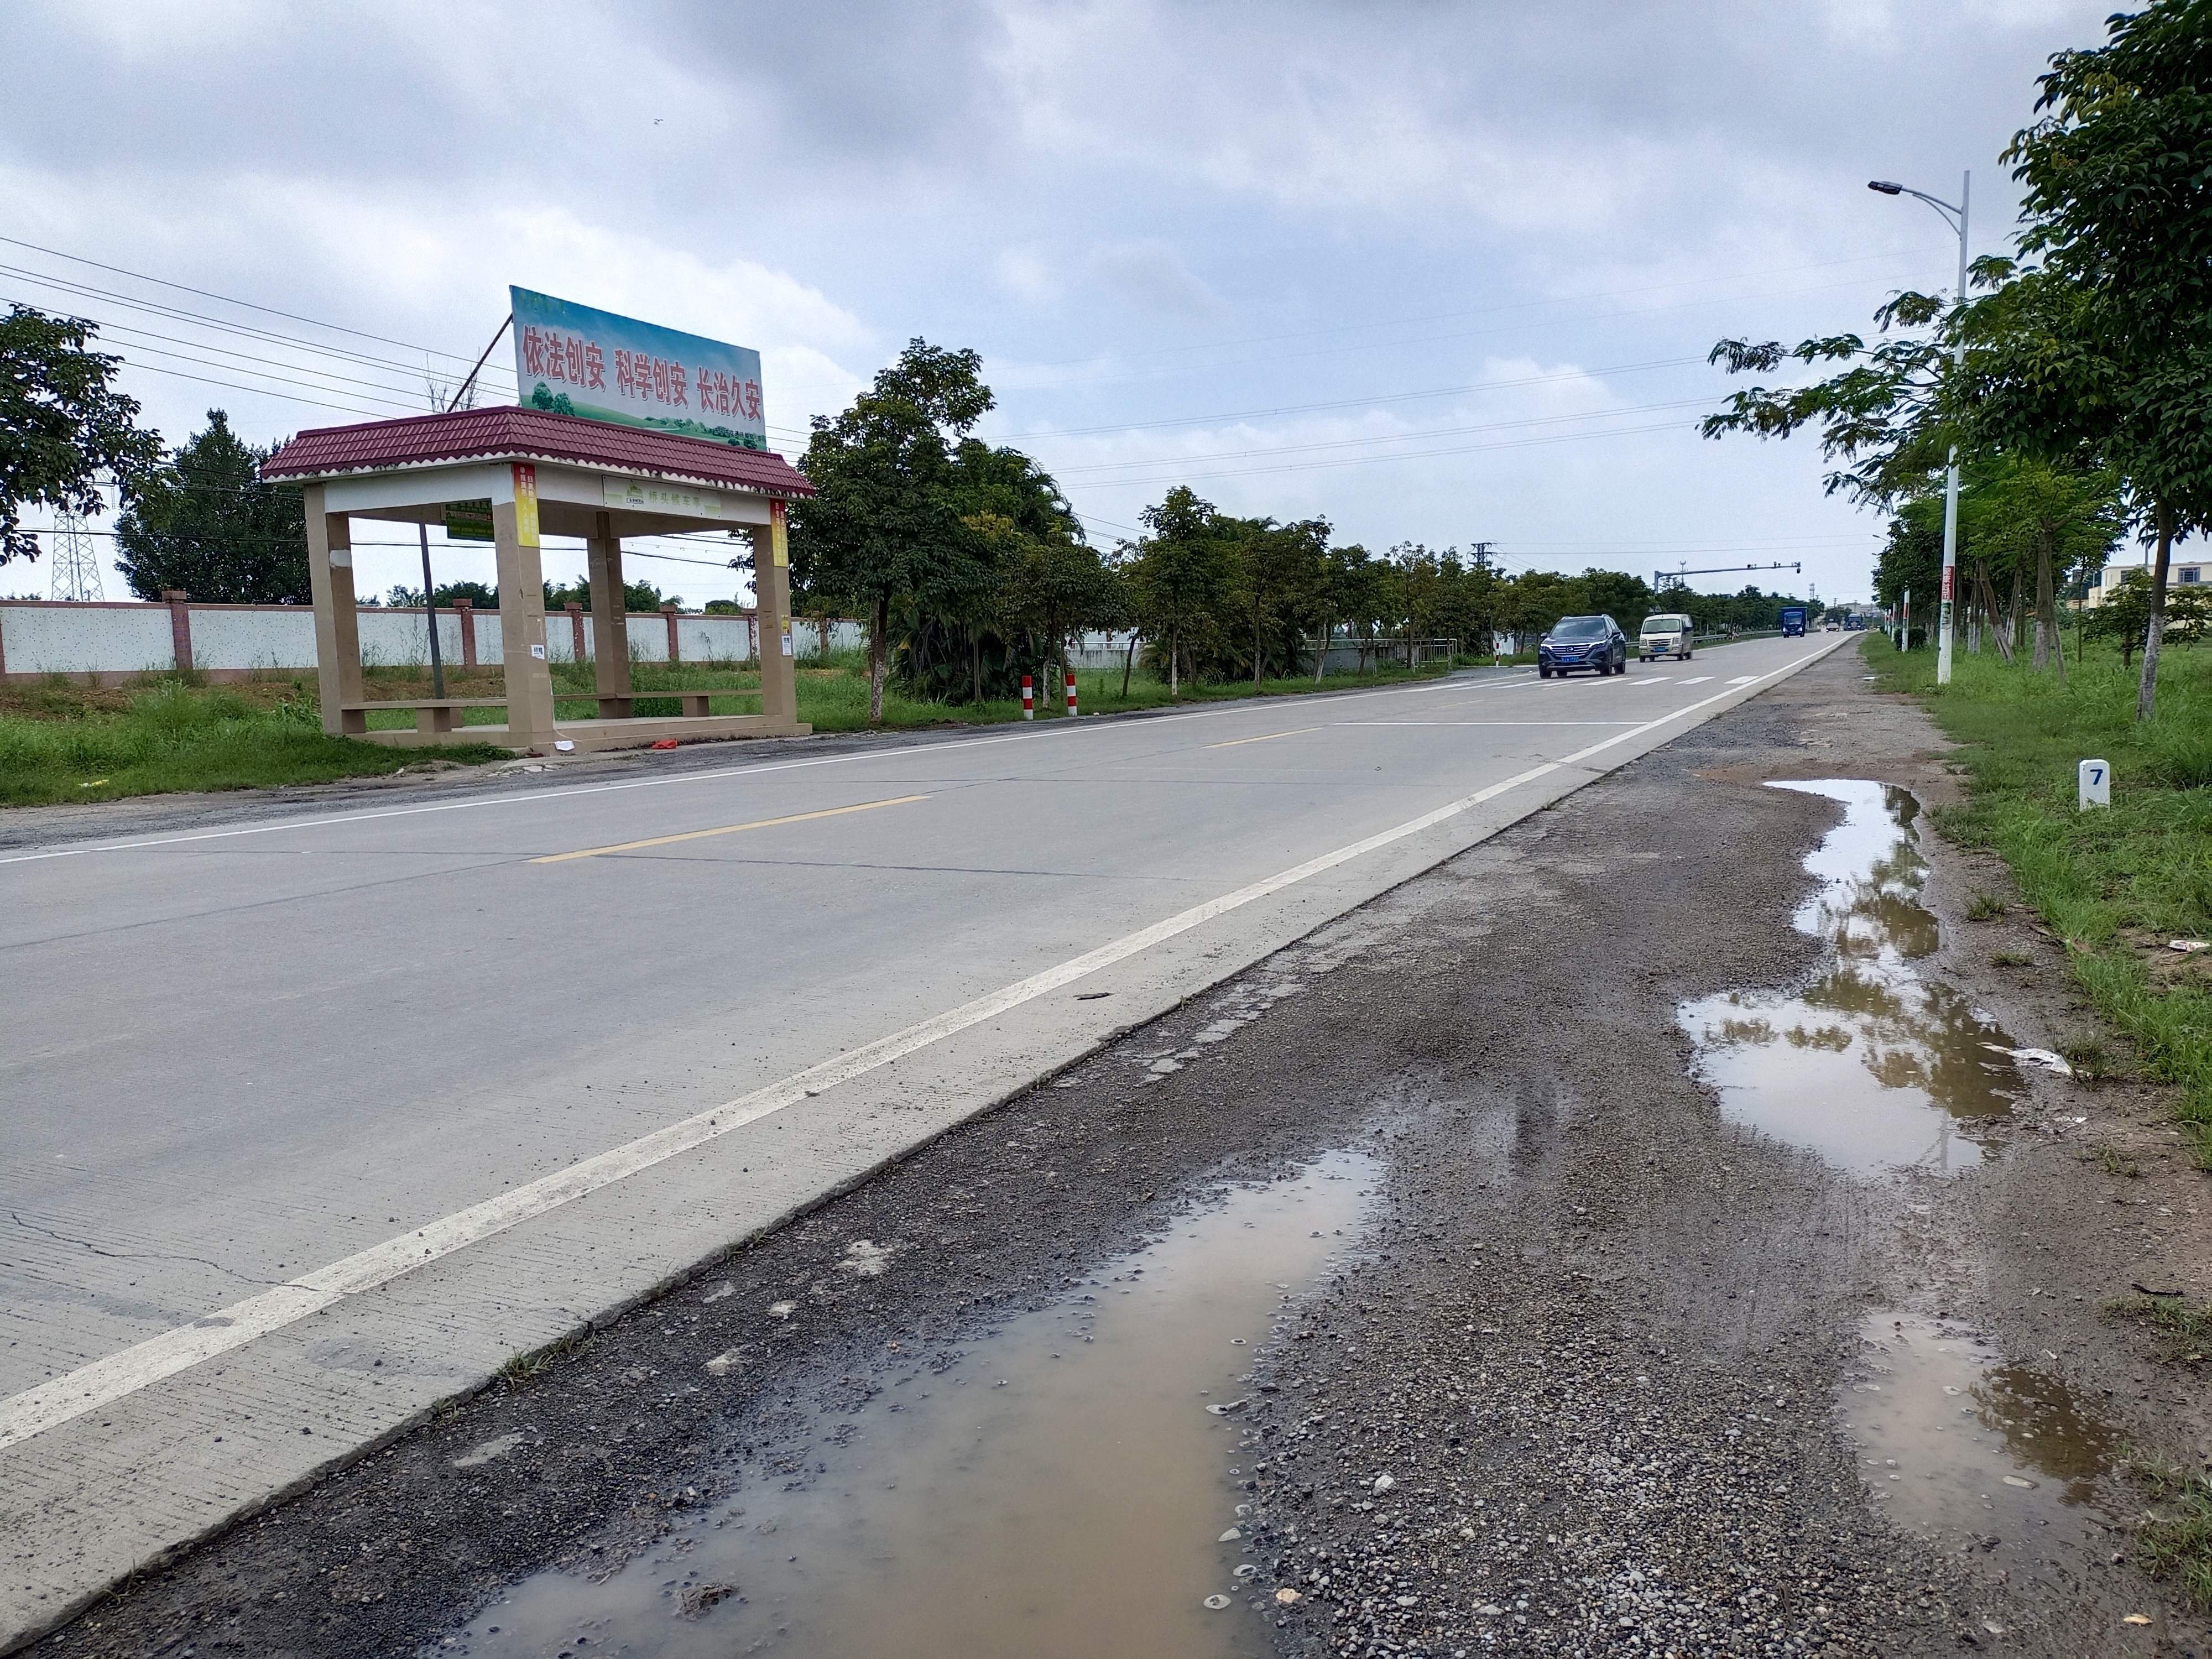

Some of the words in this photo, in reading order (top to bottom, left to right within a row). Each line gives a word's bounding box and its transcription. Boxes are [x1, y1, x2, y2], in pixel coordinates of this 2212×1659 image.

[522, 324, 606, 392] 依法创安
[614, 349, 688, 408] 科学创安
[697, 367, 761, 422] 长治久安
[649, 489, 701, 509] 桥头候车亭
[2090, 769, 2103, 785] 7
